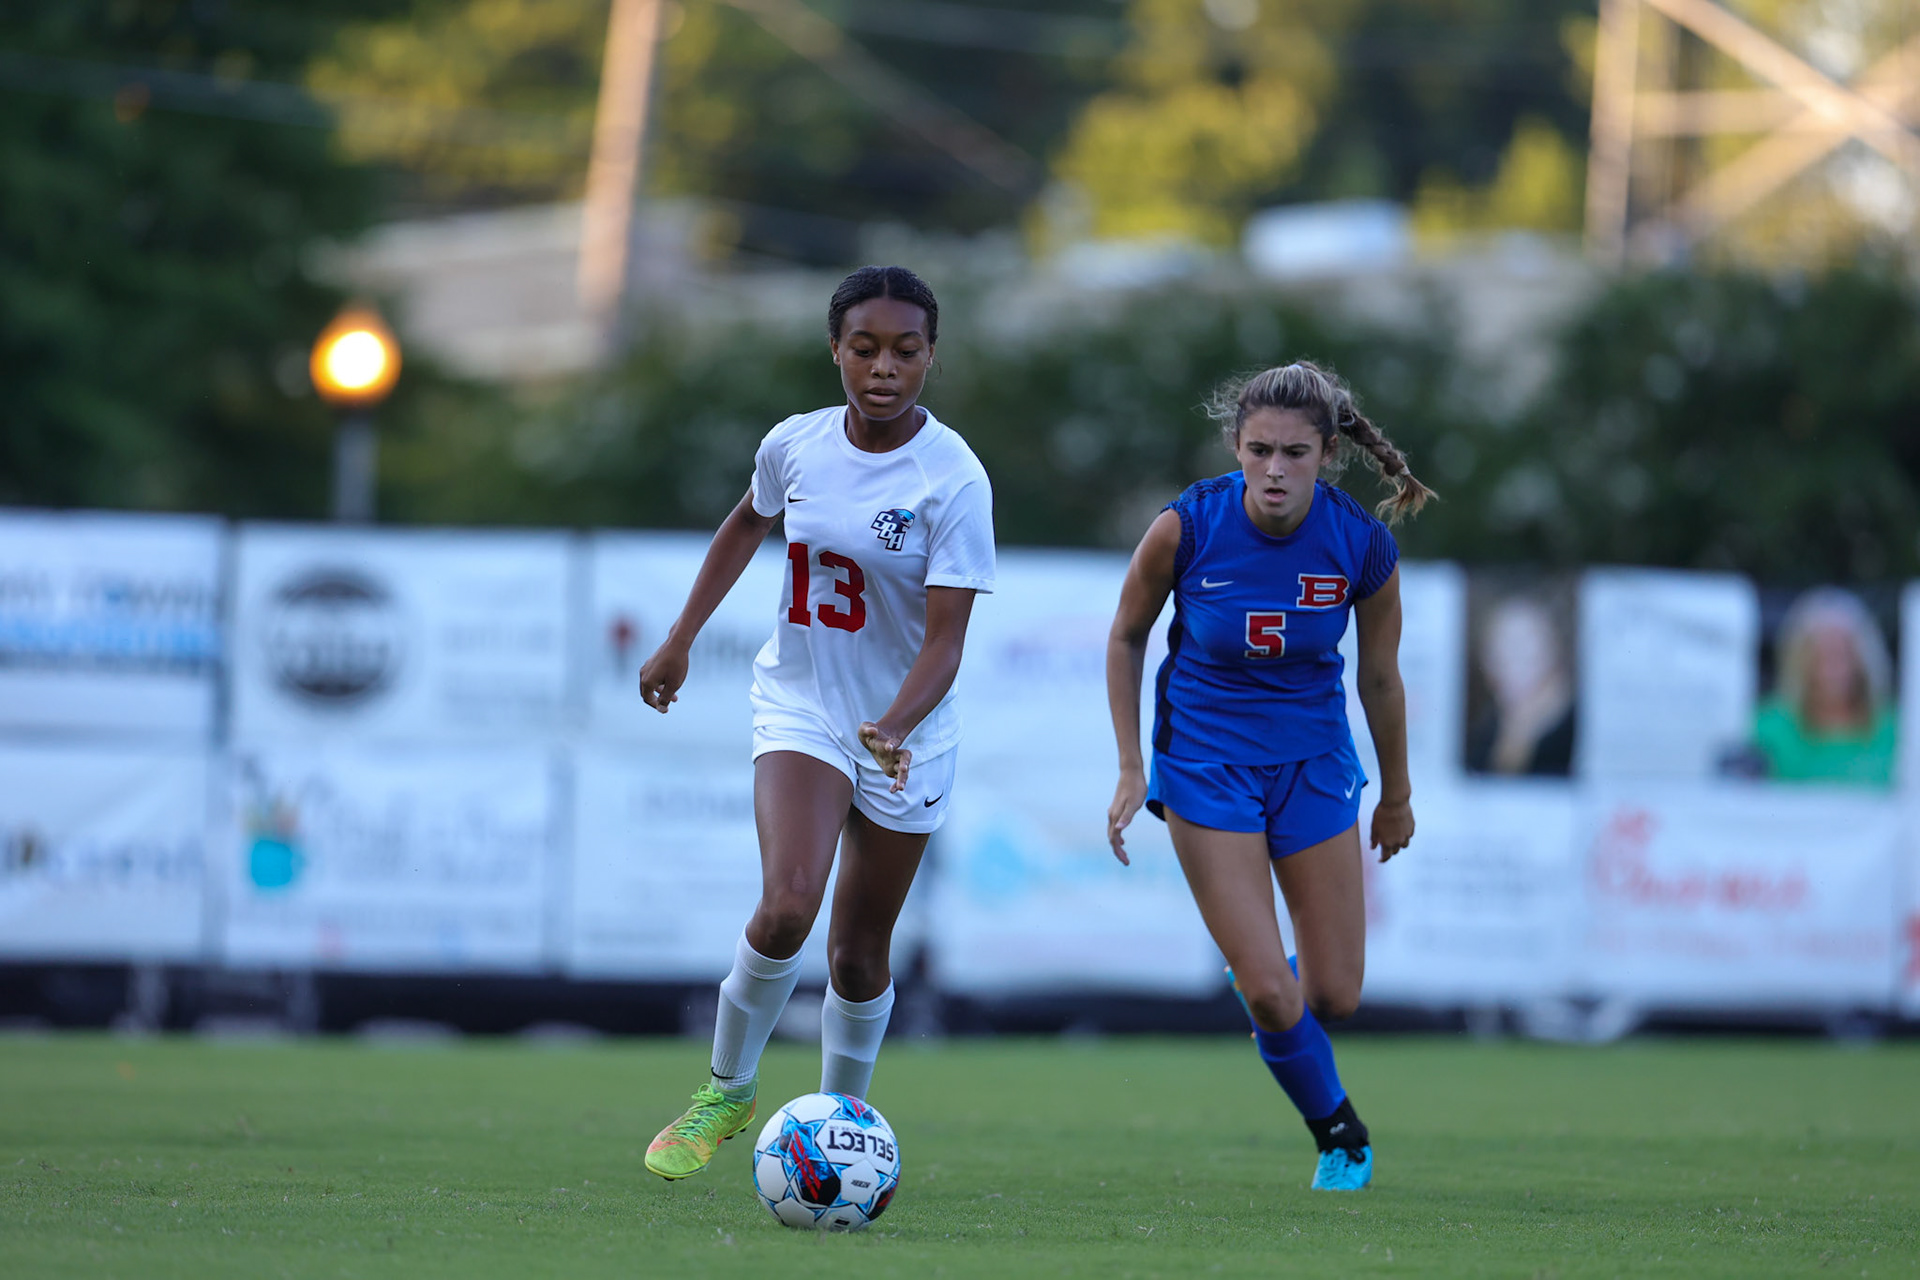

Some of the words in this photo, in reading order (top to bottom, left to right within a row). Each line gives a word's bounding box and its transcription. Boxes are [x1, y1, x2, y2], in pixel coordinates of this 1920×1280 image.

[788, 542, 866, 633] 13
[1296, 573, 1350, 609] B
[1244, 612, 1286, 659] 5
[827, 1130, 894, 1162] SELECT
